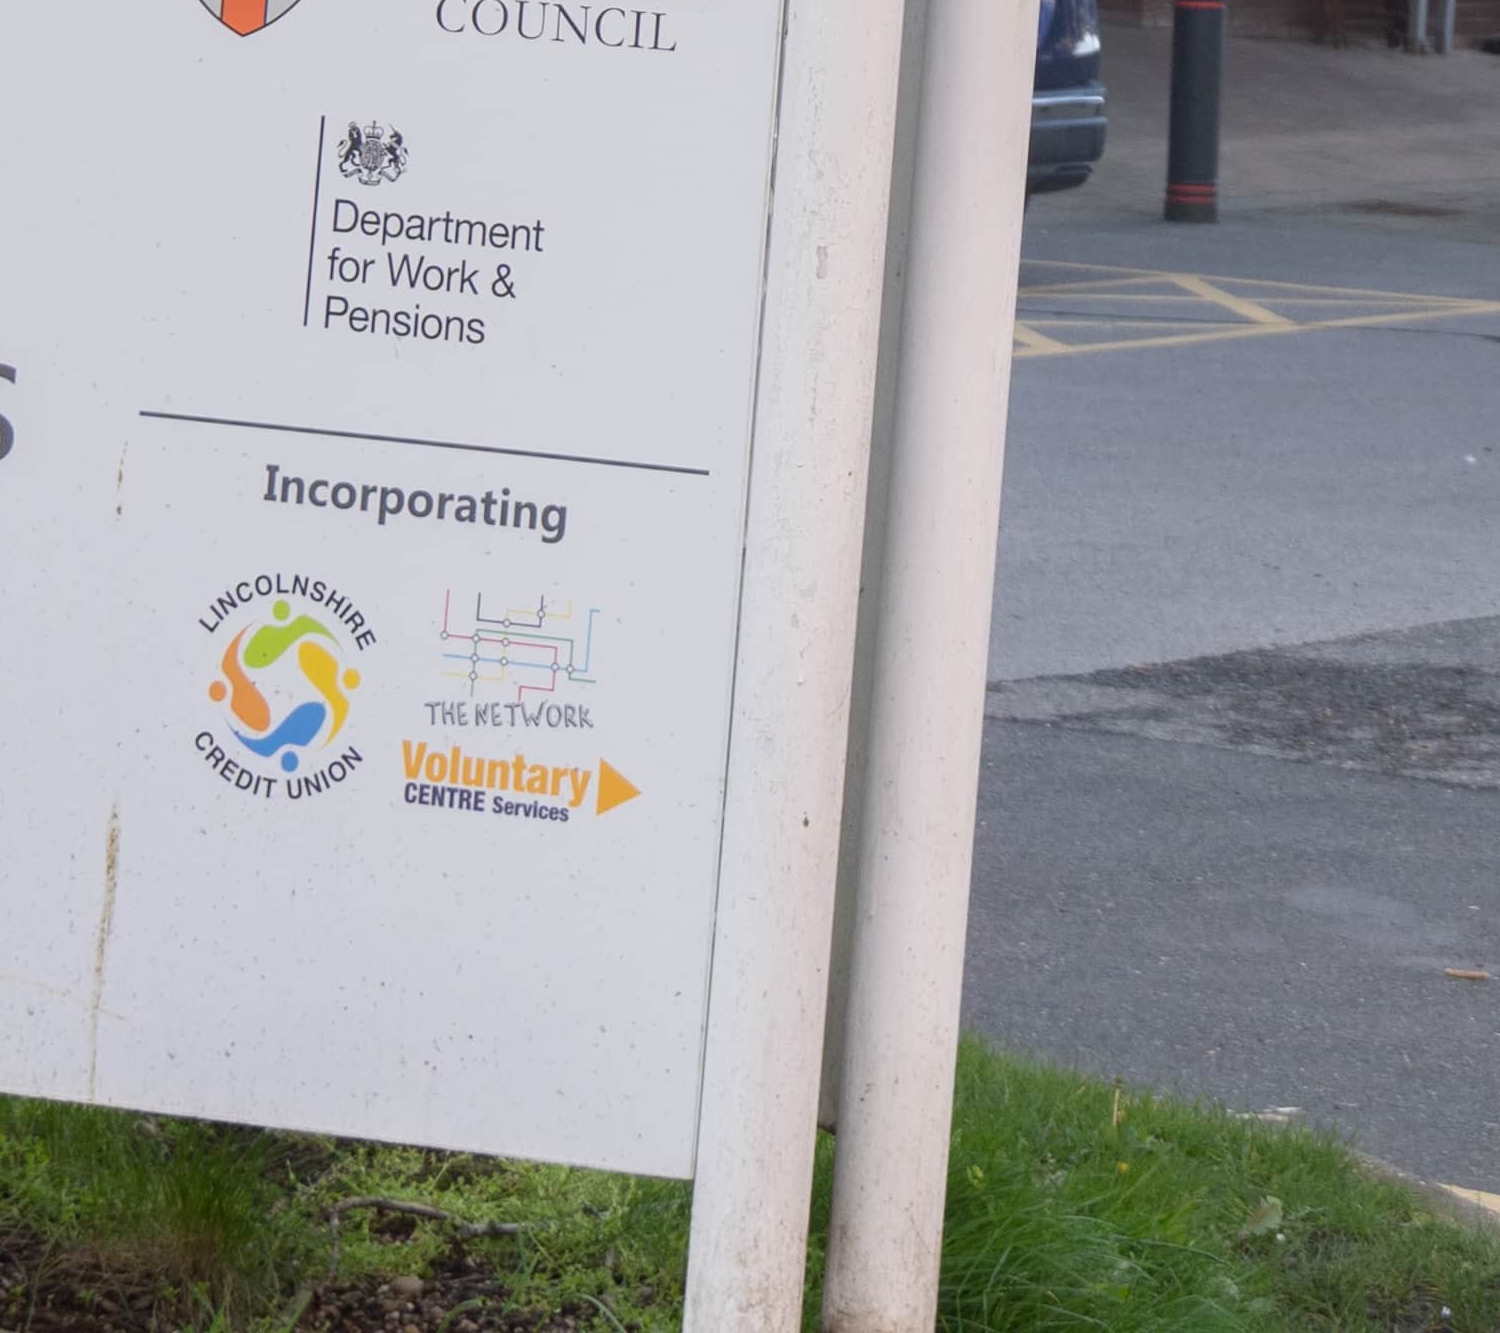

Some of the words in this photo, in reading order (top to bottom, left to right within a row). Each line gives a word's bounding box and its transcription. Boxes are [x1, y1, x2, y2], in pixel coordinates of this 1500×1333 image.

[332, 199, 544, 252] Department
[327, 248, 375, 284] for
[388, 253, 478, 295] Work
[492, 264, 516, 299] &
[324, 296, 486, 346] Pensions
[264, 465, 567, 543] Incorporating
[198, 573, 377, 651] LINCOLNSHIRE
[424, 701, 468, 727] THE
[475, 701, 594, 729] NETWORK
[195, 731, 277, 798] CREDIT
[287, 746, 363, 799] UNION
[403, 740, 591, 808] Voluntary
[404, 782, 486, 812] CENTRE
[492, 796, 569, 823] Services
